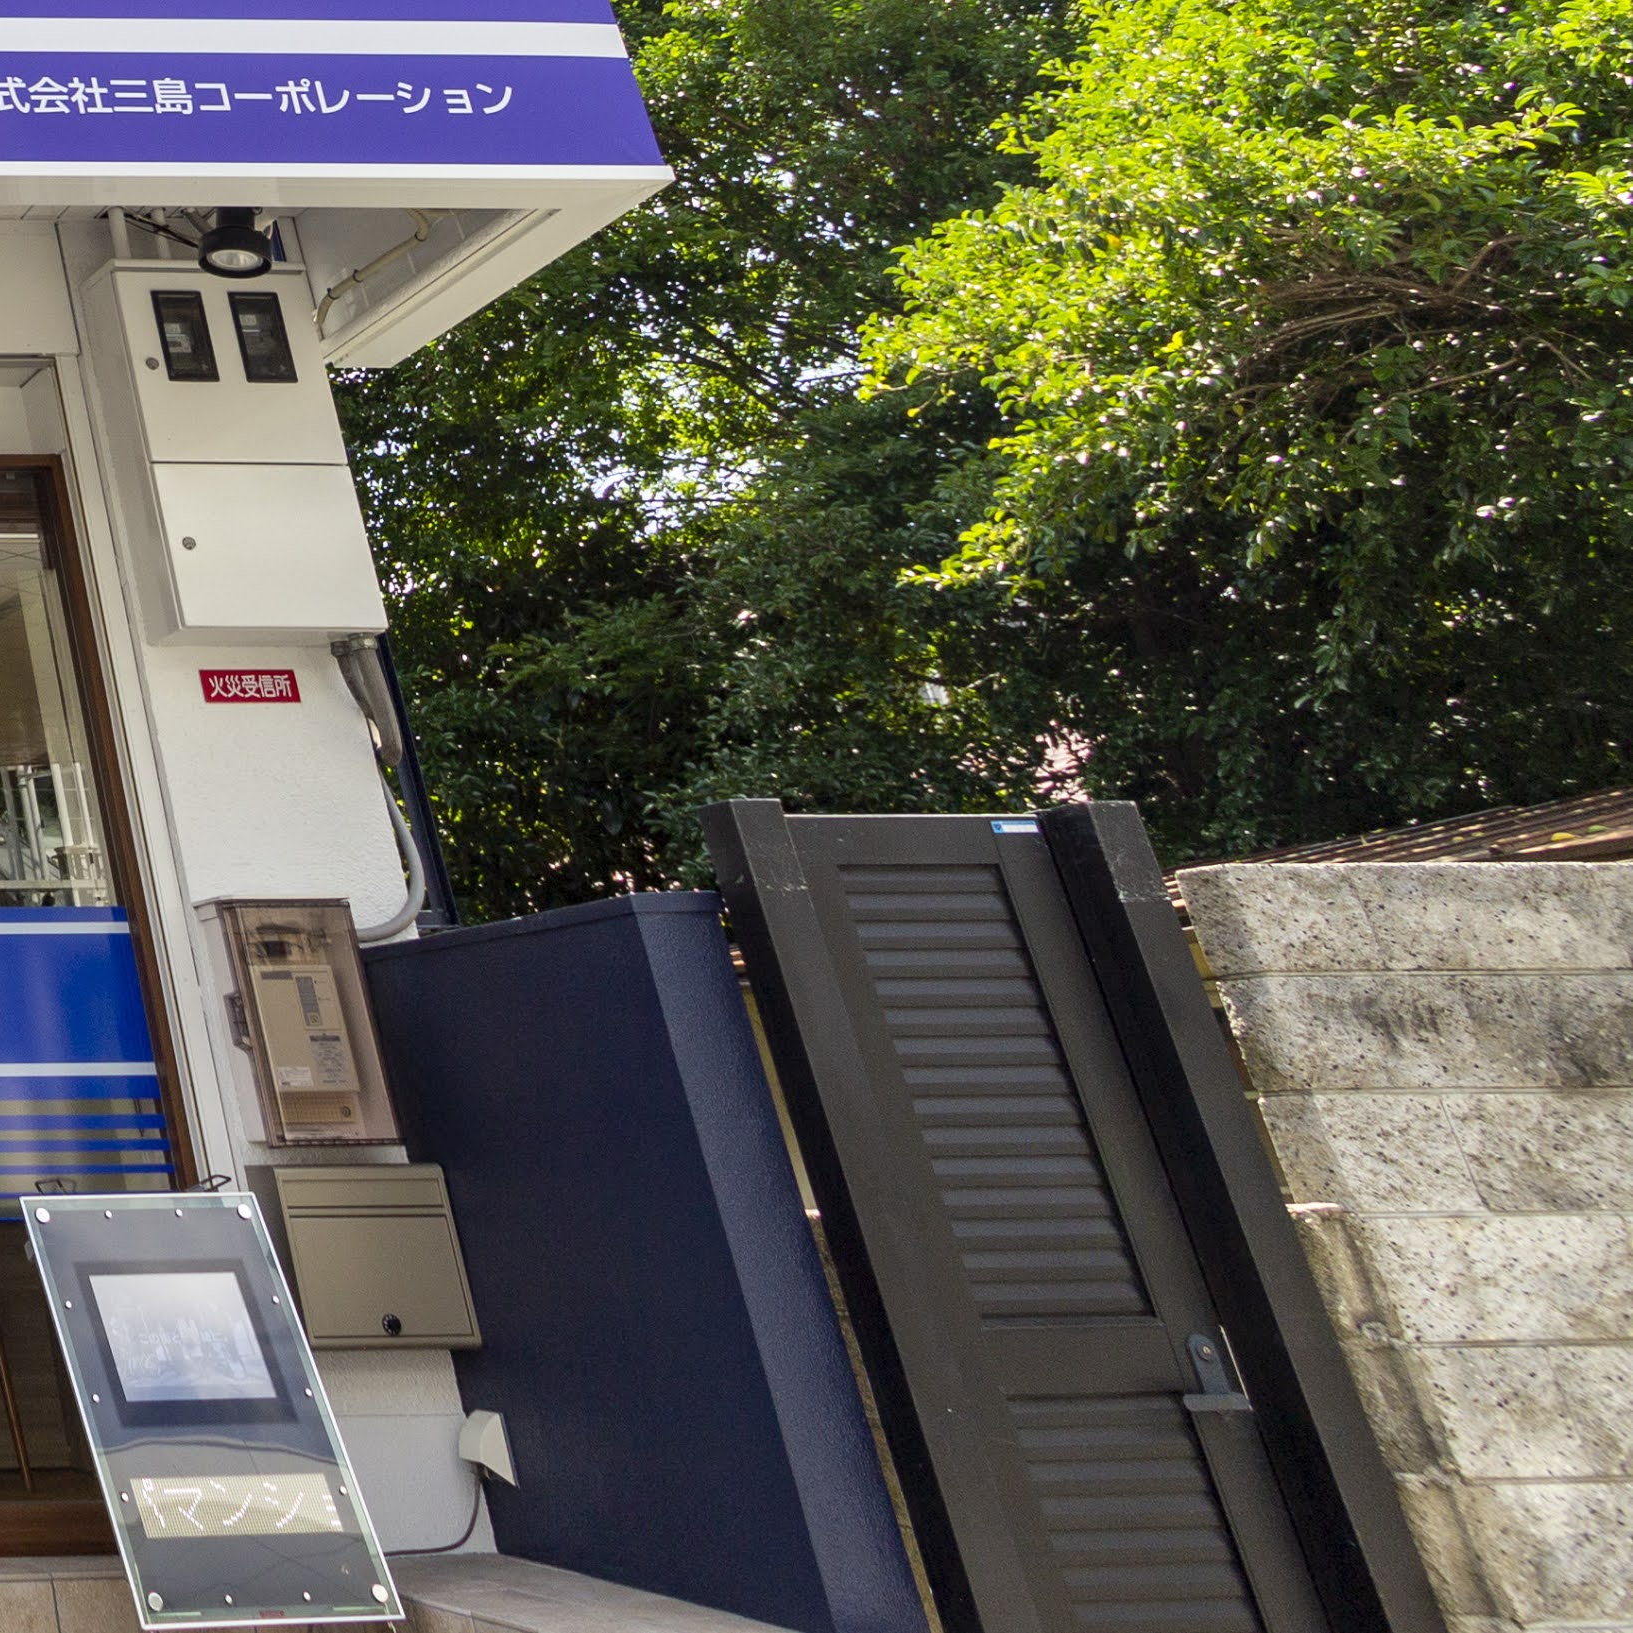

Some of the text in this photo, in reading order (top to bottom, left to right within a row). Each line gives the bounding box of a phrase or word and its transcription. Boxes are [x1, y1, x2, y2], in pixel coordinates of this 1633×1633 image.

[208, 674, 293, 698] 火災受信所
